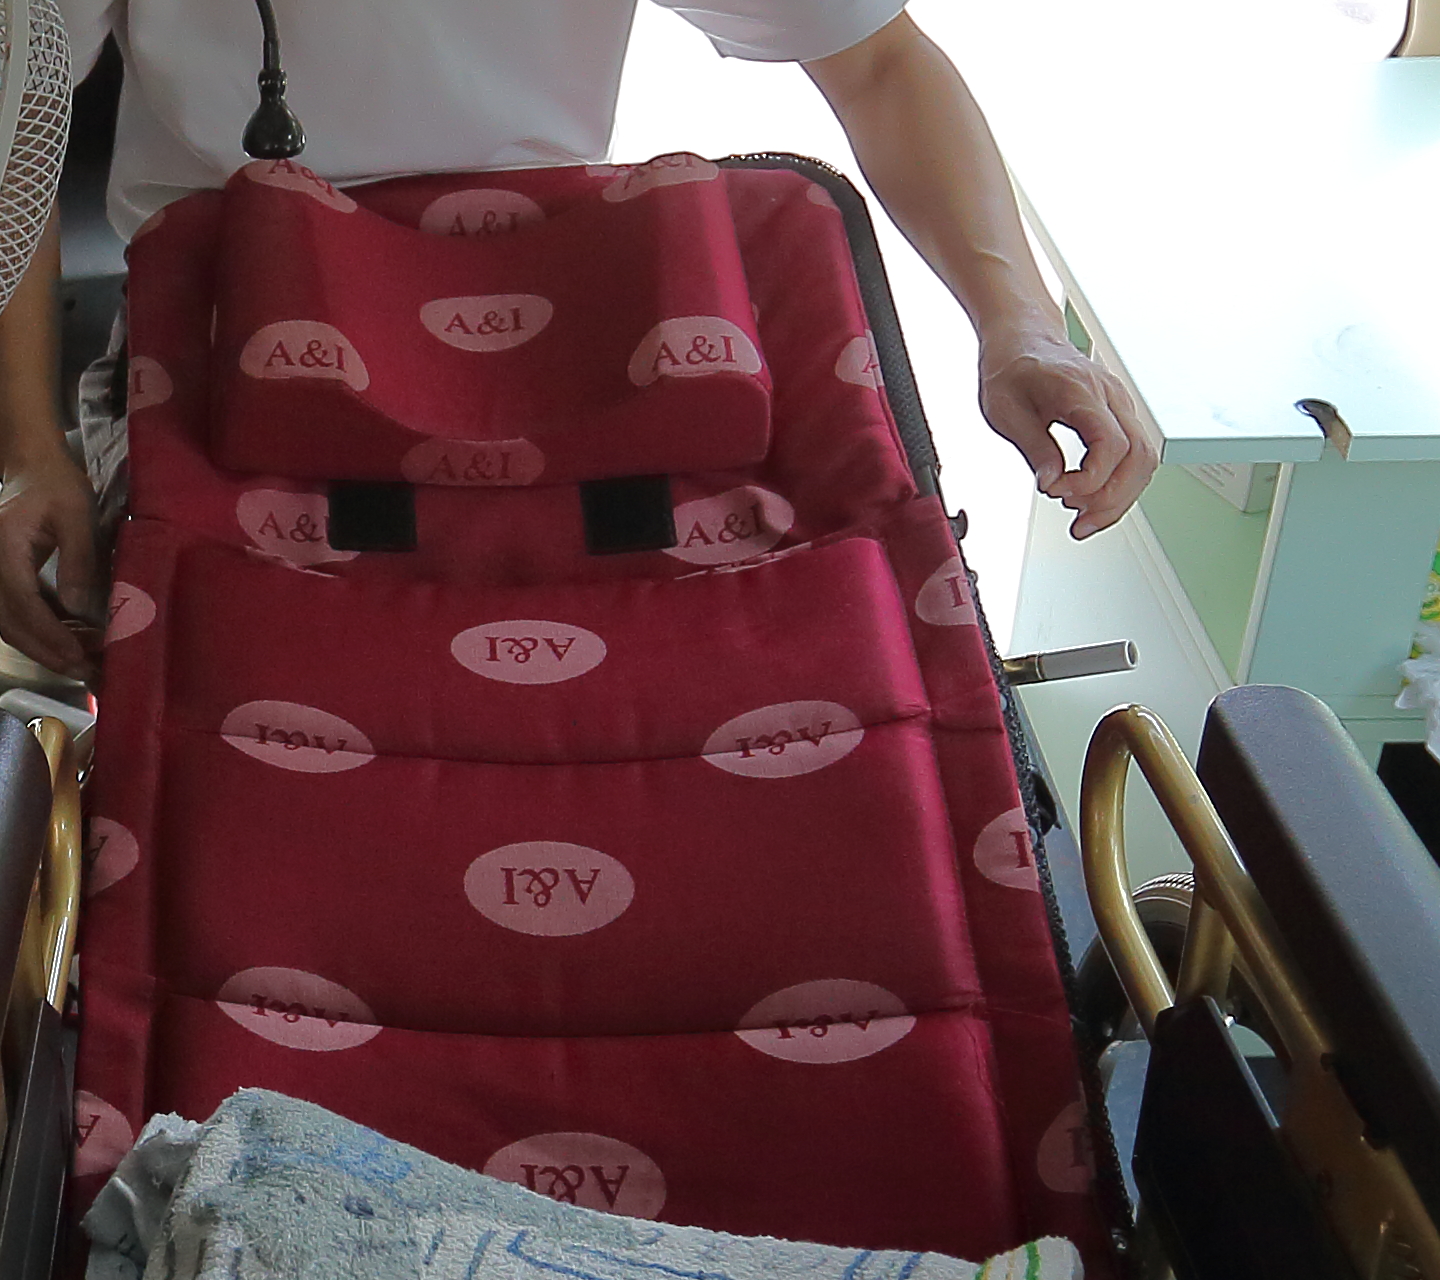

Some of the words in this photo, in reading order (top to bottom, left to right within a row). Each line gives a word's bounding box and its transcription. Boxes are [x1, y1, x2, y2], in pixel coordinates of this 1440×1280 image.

[444, 308, 527, 336] A&I
[264, 339, 348, 373] A&I
[653, 334, 738, 371] A&I
[428, 452, 514, 482] A&I
[258, 510, 327, 543] A&
[683, 505, 768, 548] A&I
[484, 635, 577, 665] A&I
[499, 866, 601, 909] A&I
